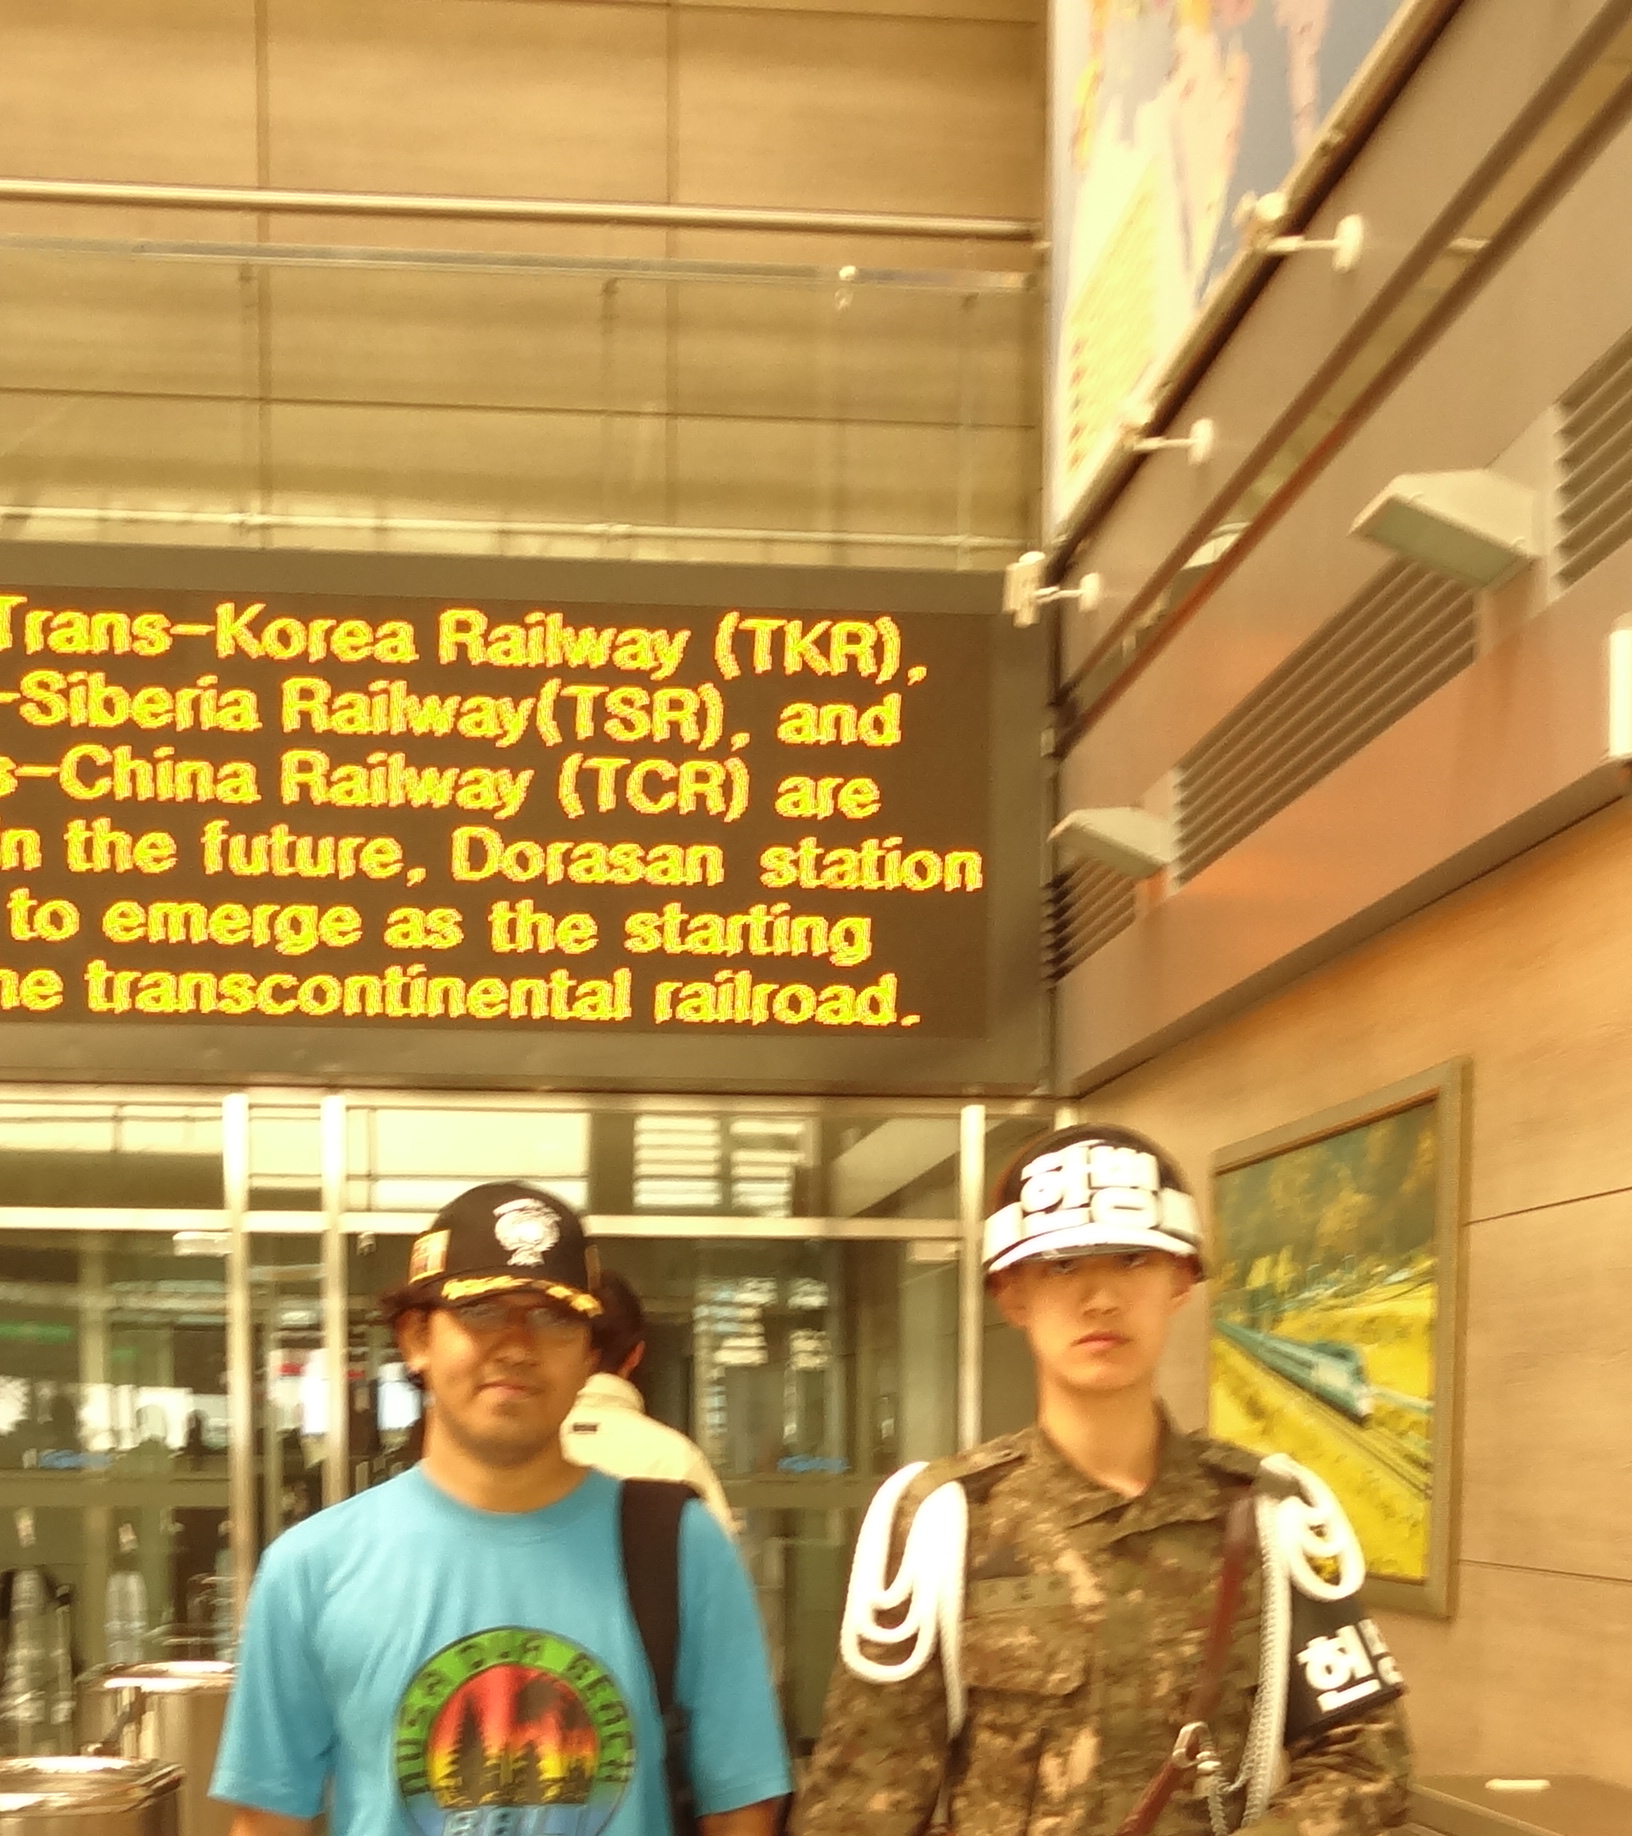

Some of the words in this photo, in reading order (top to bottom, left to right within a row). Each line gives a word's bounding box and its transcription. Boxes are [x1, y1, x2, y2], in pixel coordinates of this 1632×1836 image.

[437, 607, 690, 682] Railway
[713, 610, 928, 687] (TKR),
[280, 675, 751, 753] Railway(TSR),
[776, 691, 903, 748] and
[279, 747, 536, 821] Railway
[557, 751, 751, 824] (TCR)
[773, 775, 883, 821] are
[62, 815, 179, 875] the
[199, 818, 428, 886] future,
[450, 824, 726, 888] Dorasan
[758, 835, 984, 893] station
[5, 886, 81, 943] to
[100, 899, 363, 957] emerge
[382, 906, 466, 951] as
[486, 898, 599, 956] the
[622, 900, 874, 968] starting
[82, 958, 633, 1023] transcontinental
[653, 968, 922, 1028] railroad.
[1020, 1138, 1159, 1232] 헌병
